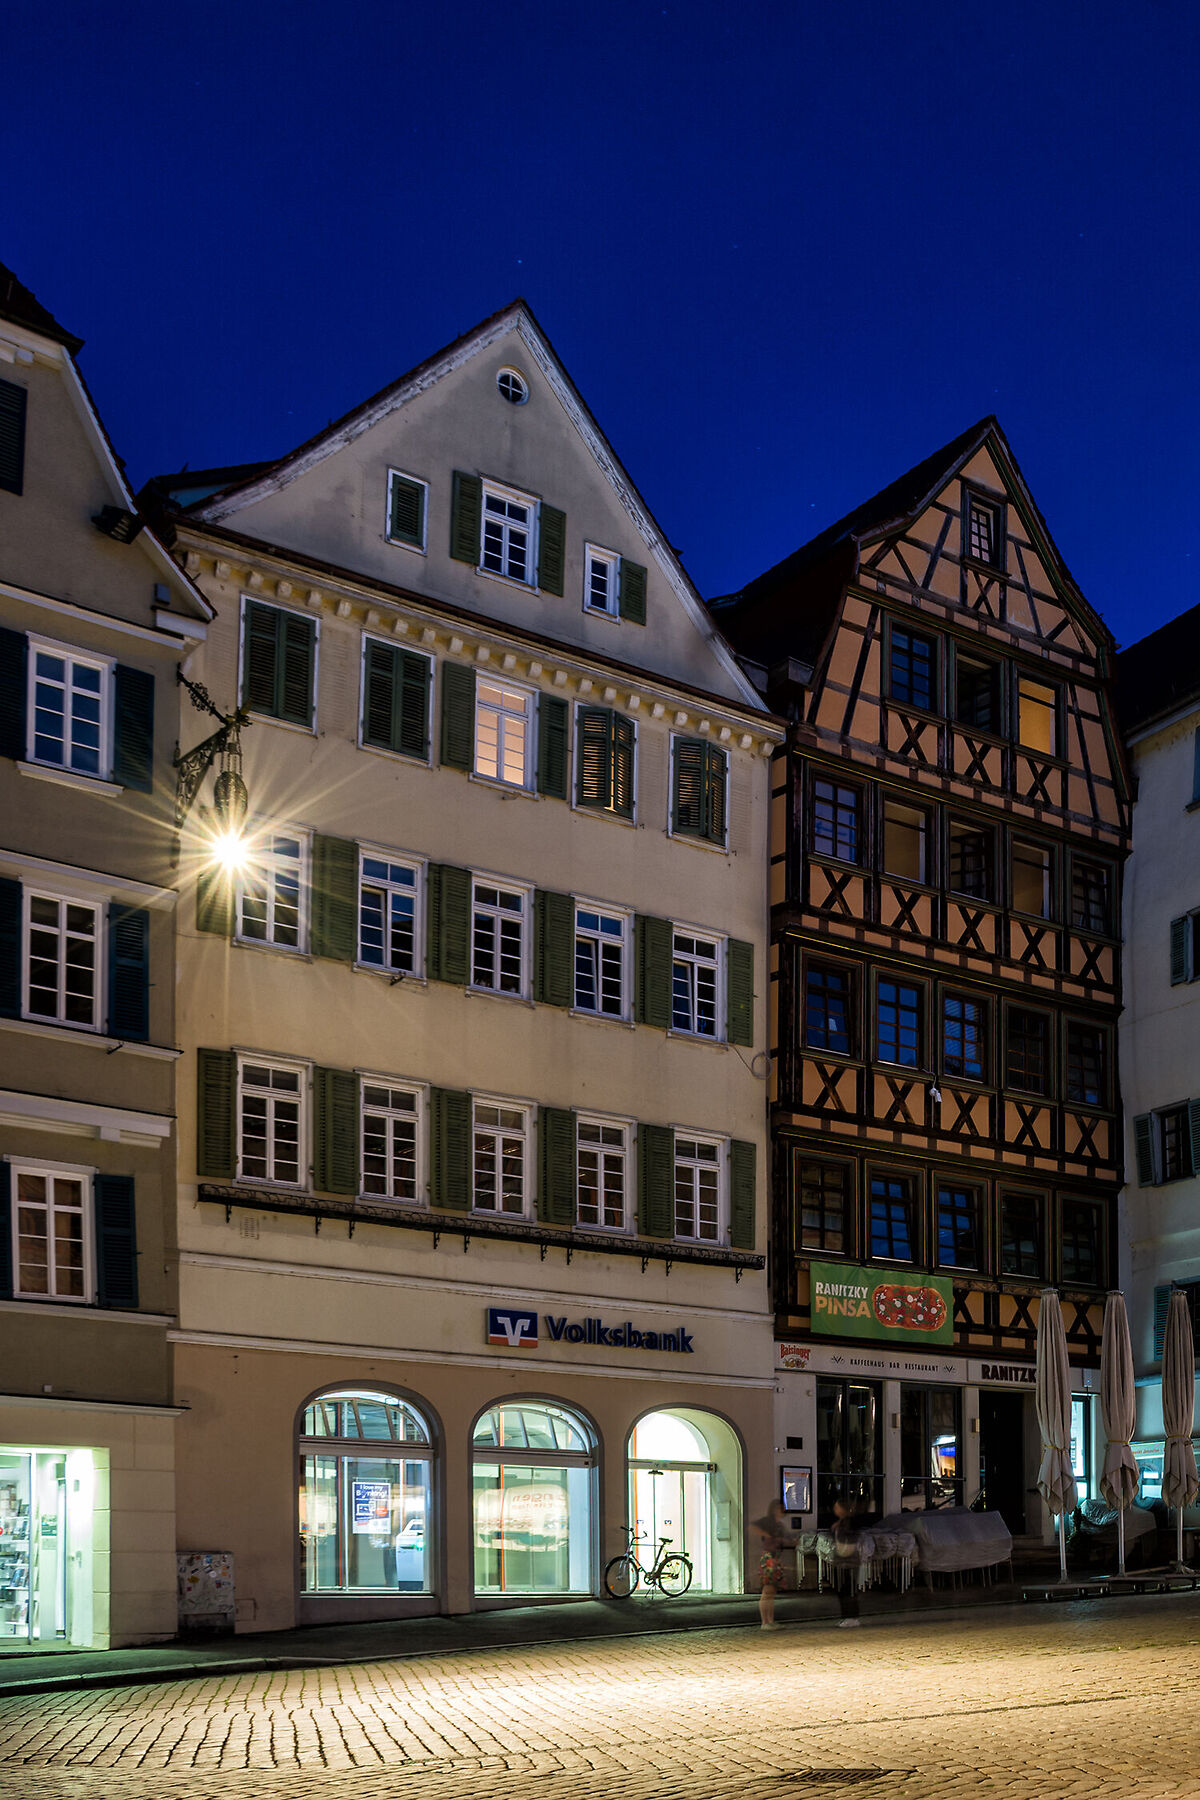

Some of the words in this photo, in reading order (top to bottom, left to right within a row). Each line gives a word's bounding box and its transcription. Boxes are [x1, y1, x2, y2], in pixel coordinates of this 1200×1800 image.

[815, 1281, 869, 1299] RANITZKY
[815, 1295, 872, 1318] PINSA
[544, 1315, 694, 1353] Volksbank
[850, 1358, 885, 1369] KAFFEEHAUS
[889, 1361, 900, 1369] BAR
[904, 1362, 939, 1373] RESTAURANT
[981, 1364, 1037, 1383] RANITZK
